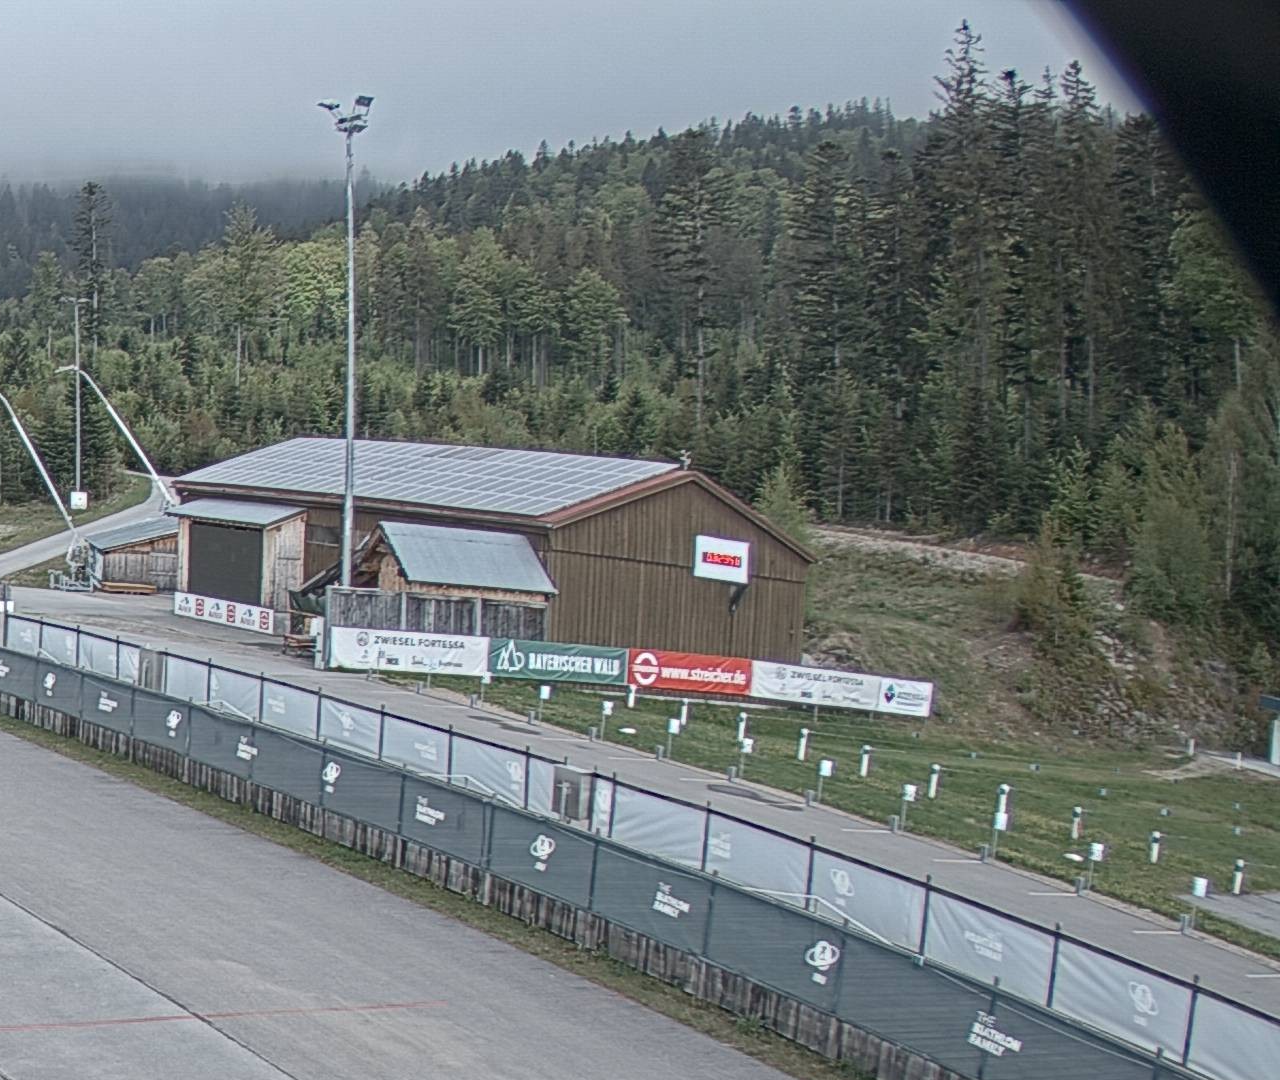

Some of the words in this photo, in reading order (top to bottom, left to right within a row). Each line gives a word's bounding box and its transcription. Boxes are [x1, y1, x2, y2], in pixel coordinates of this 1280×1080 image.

[373, 635, 416, 647] ZWIESEL
[527, 652, 592, 673] BAYERISCHER
[593, 657, 620, 676] WALD
[661, 666, 746, 685] www.streicher.de
